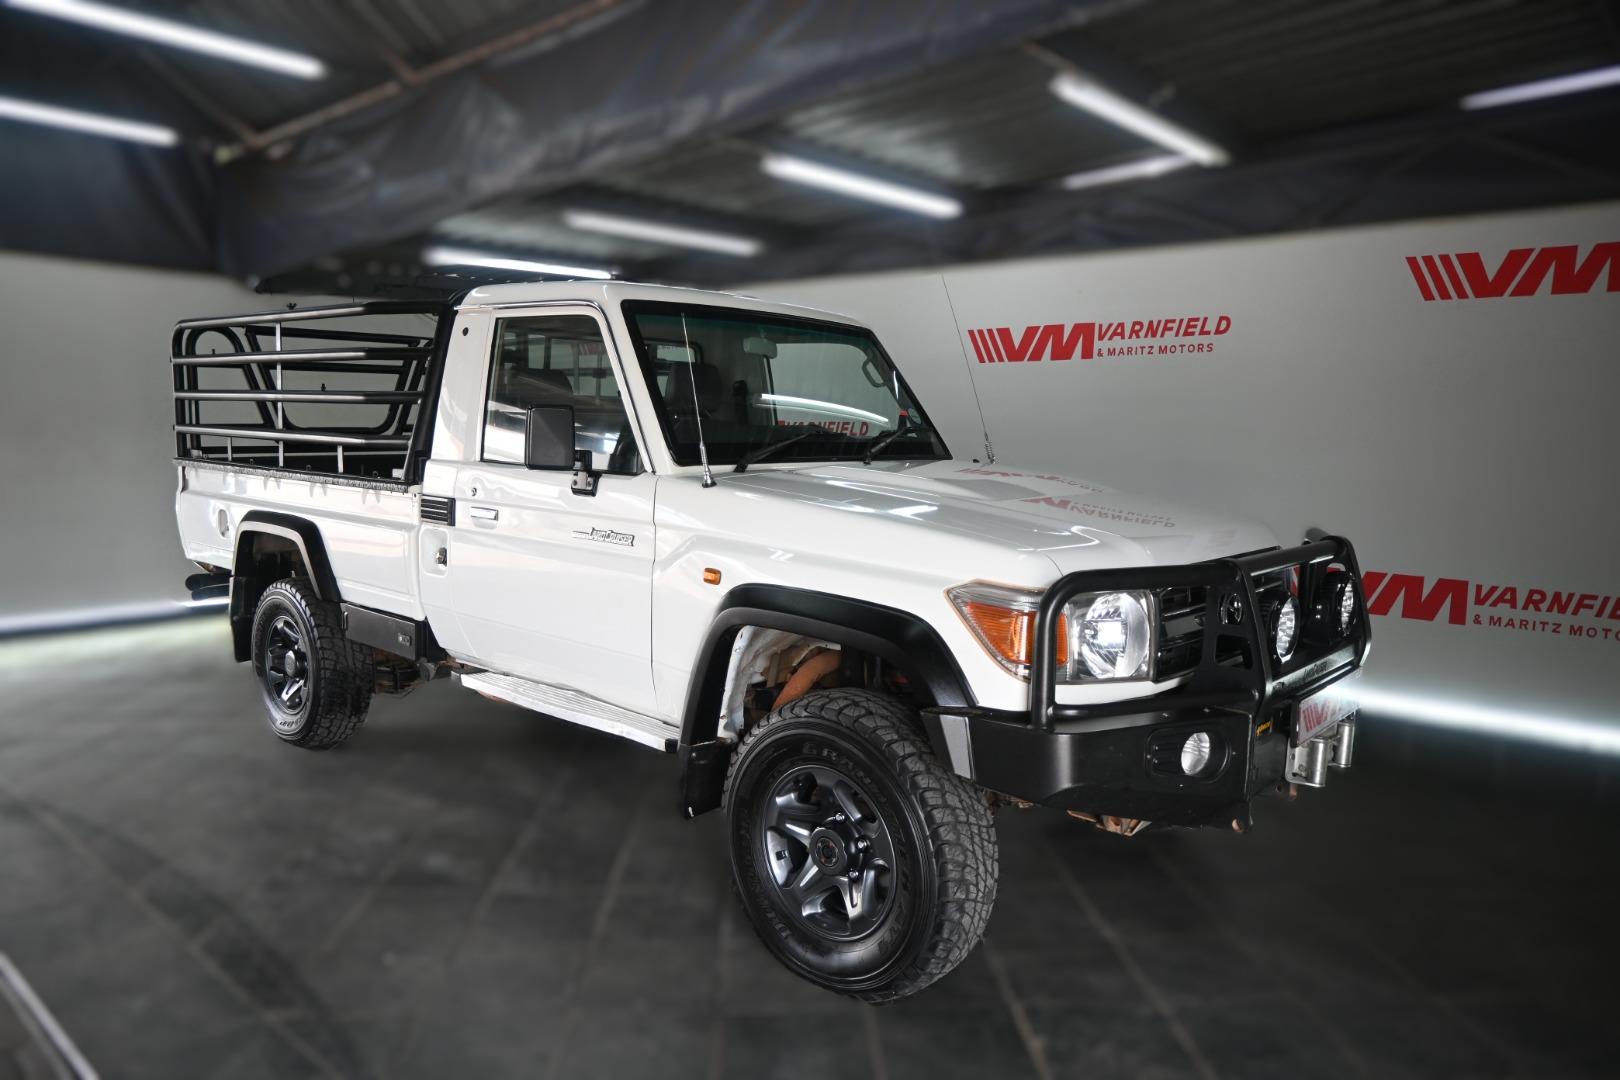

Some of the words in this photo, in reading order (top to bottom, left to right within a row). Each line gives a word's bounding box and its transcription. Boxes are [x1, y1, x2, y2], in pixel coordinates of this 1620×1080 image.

[1097, 315, 1232, 341] VARNFIELD
[996, 322, 1096, 362] VM
[1097, 347, 1104, 357] &
[1107, 345, 1154, 357] MARITZ
[1158, 343, 1215, 355] MOTORS
[1473, 614, 1482, 625] &
[1488, 615, 1562, 634] MARITZ
